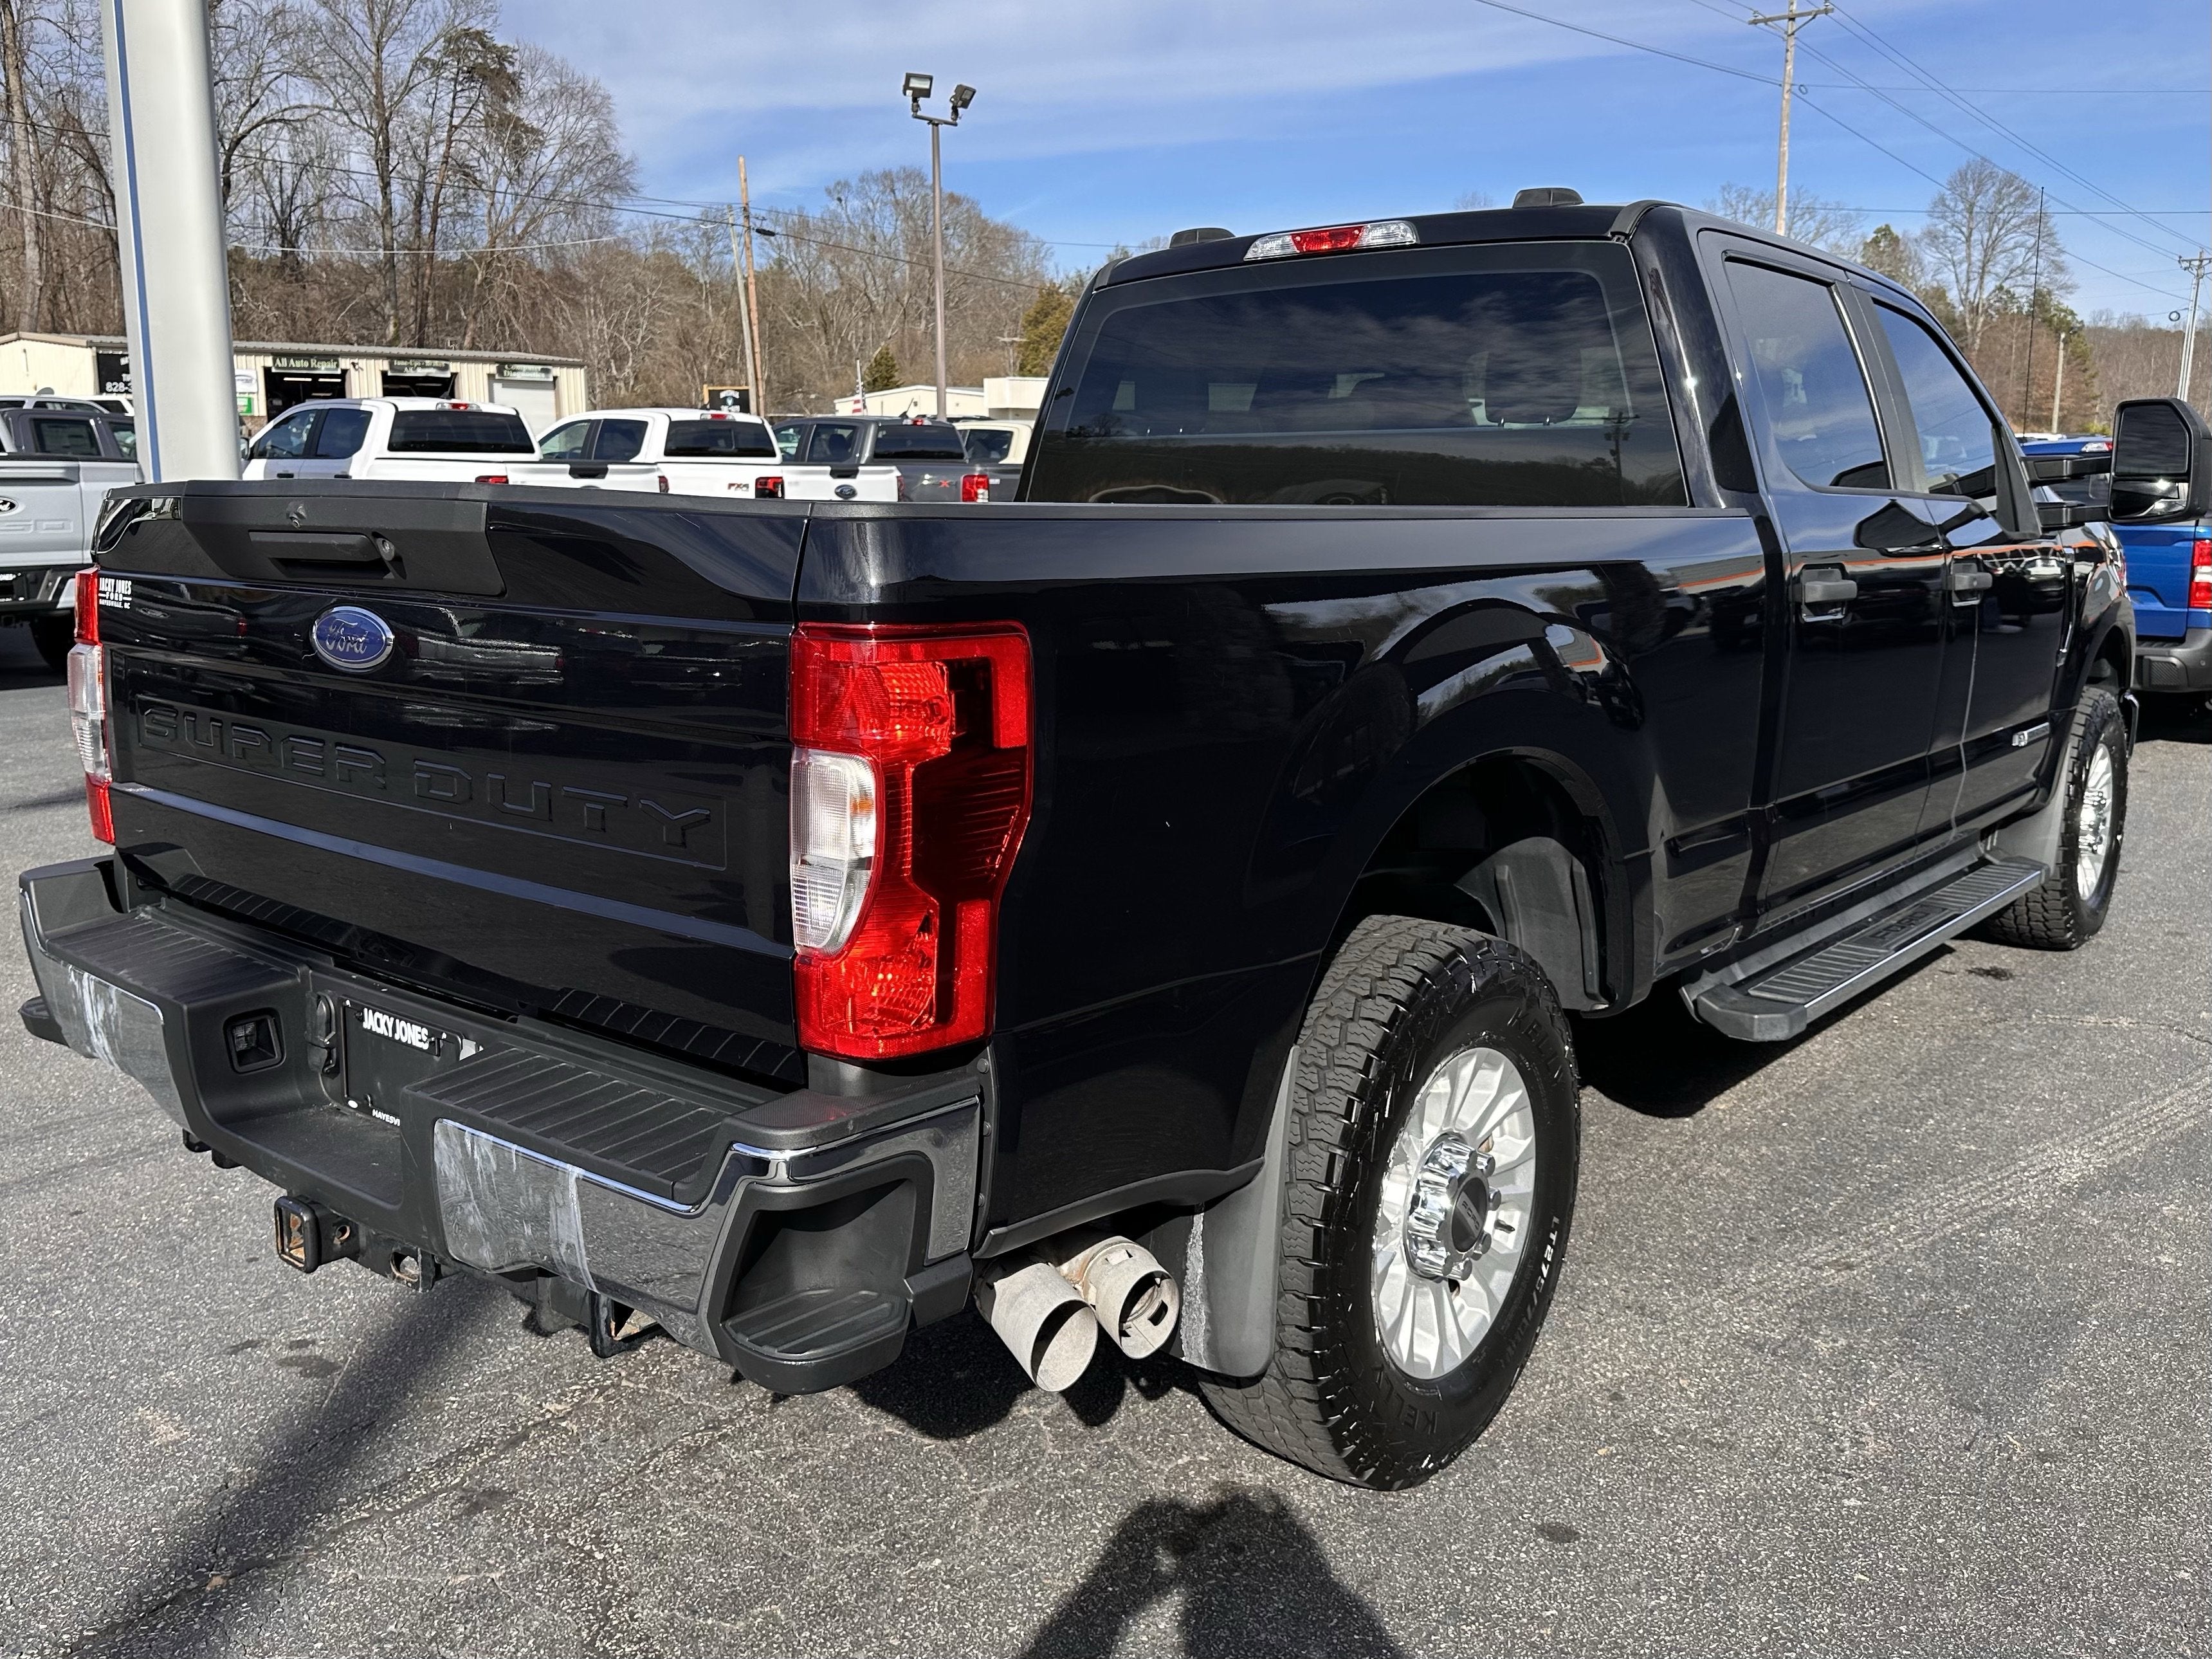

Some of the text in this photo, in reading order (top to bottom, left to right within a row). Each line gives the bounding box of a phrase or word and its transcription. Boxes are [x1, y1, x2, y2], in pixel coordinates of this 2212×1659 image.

[275, 358, 288, 367] All
[289, 358, 309, 368] Auto
[105, 591, 123, 601] FORD
[326, 618, 370, 654] Ford
[143, 707, 711, 848] SUPER DUTY
[363, 1007, 430, 1050] JACKY JONES
